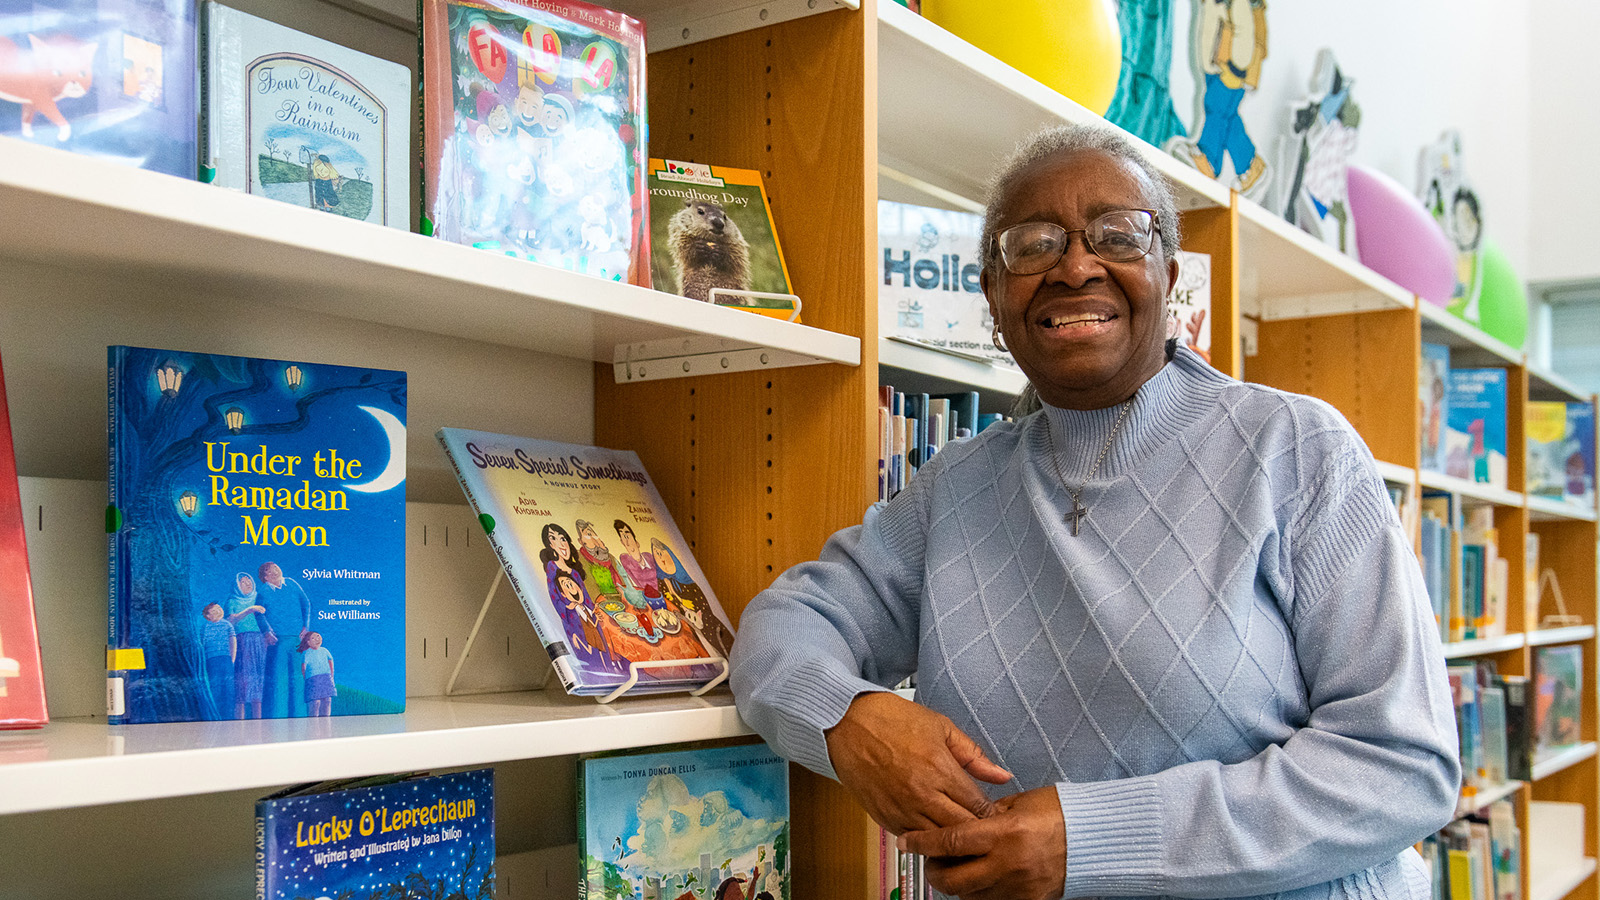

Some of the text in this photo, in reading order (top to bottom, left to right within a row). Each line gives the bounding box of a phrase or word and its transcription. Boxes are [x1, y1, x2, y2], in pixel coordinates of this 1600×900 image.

[532, 0, 569, 17] Hoying
[579, 10, 605, 27] Mark
[608, 20, 640, 42] Hoying
[468, 29, 614, 89] FA LA LA
[258, 66, 379, 124] Four Valentines
[308, 96, 336, 117] in a
[275, 100, 361, 141] Rainstorm
[650, 187, 749, 207] roundhog Day
[949, 339, 980, 350] section
[203, 441, 362, 480] Under the
[466, 442, 648, 487] Seven Special Somethings
[207, 475, 350, 511] Ramadan
[240, 515, 330, 547] Moon
[302, 569, 381, 580] Sylvia Whitman
[318, 610, 381, 620] Sue Williams
[363, 599, 371, 607] by
[623, 770, 646, 779] TONYA
[649, 766, 676, 777] DUNCAN
[679, 764, 696, 774] ELLIS
[728, 760, 747, 768] JENIN
[256, 816, 265, 850] LUCKY
[296, 798, 476, 848] Lucky O'Leprechaun
[314, 849, 347, 866] Written
[349, 846, 366, 860] and
[368, 837, 410, 857] Illustrated
[411, 834, 421, 848] by
[422, 831, 440, 845] Jana
